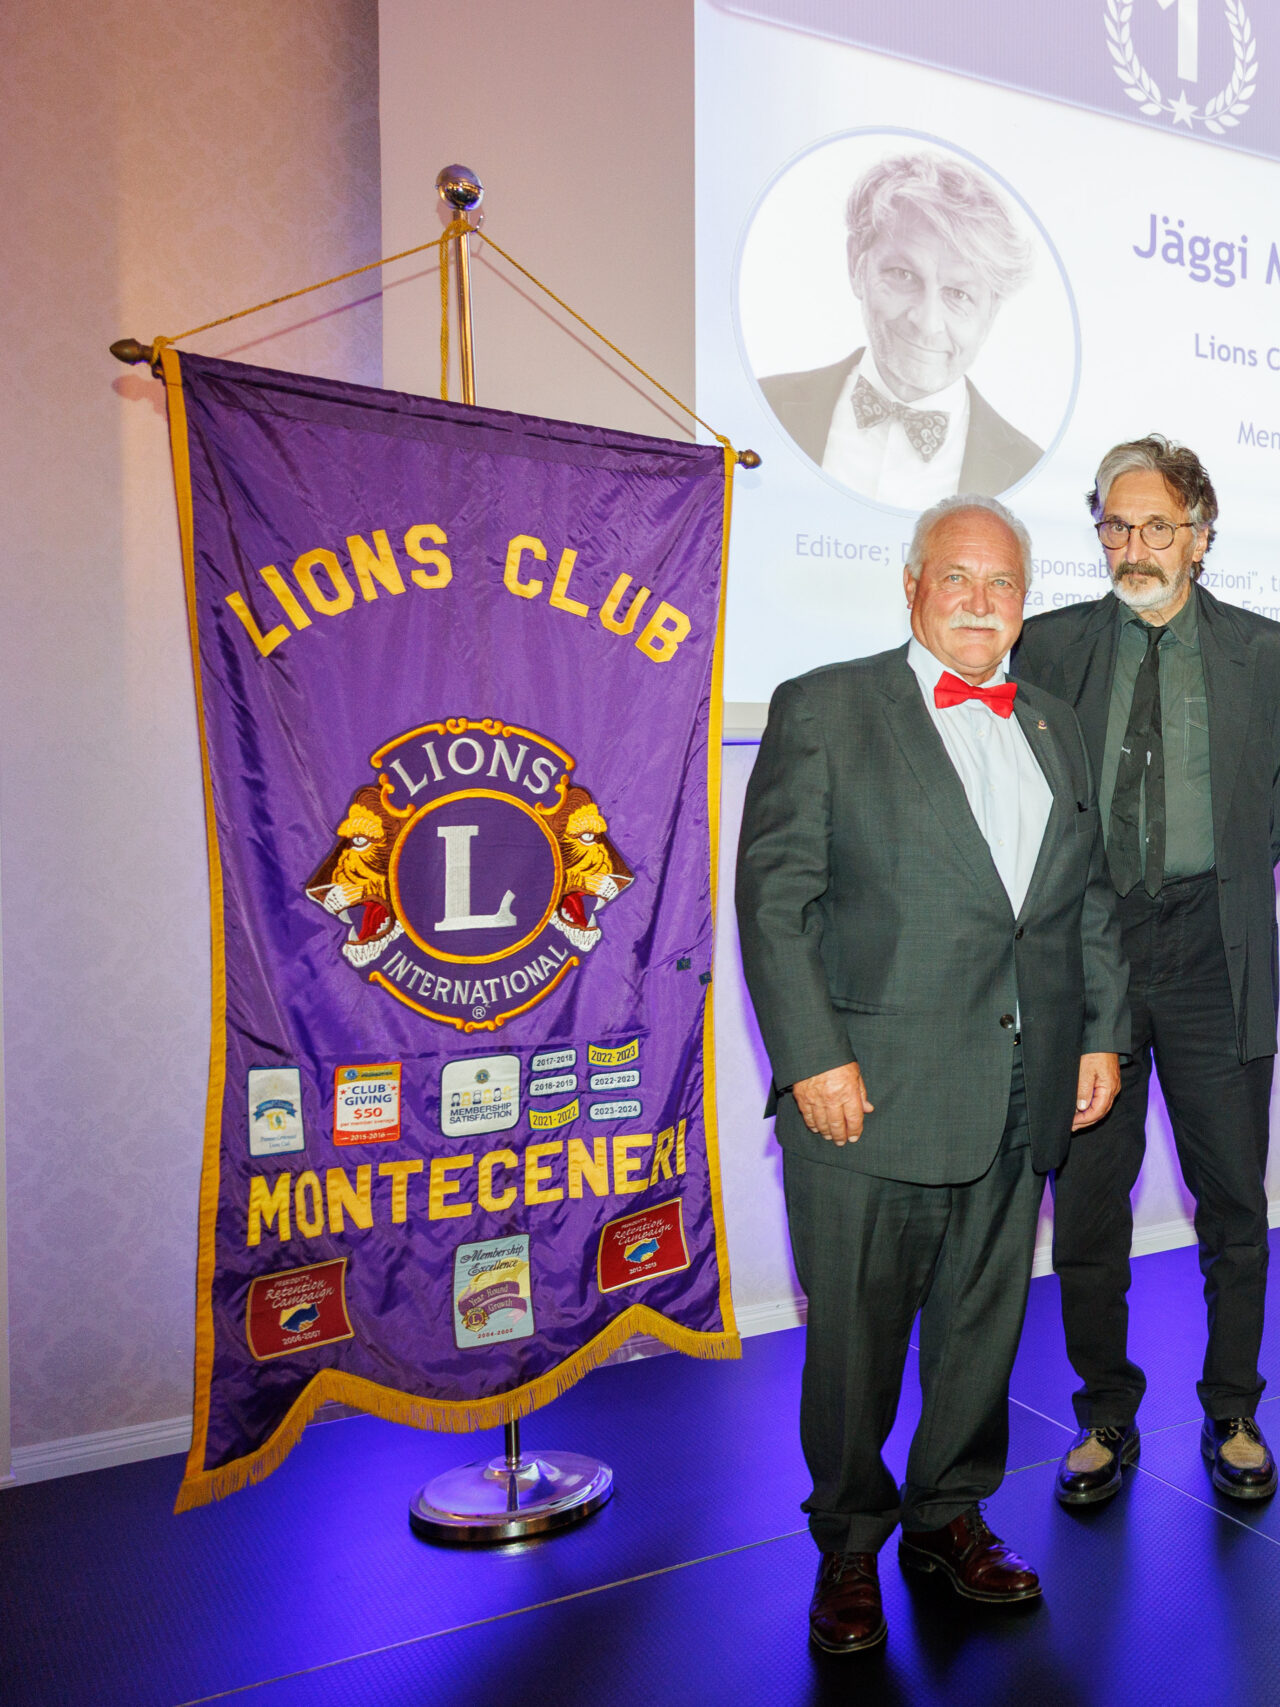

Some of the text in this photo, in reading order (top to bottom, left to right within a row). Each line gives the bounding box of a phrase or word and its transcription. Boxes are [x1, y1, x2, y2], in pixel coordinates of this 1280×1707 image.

[1132, 213, 1249, 288] Jäggi
[1193, 332, 1259, 367] Lions
[796, 533, 890, 566] Editore;
[1031, 558, 1109, 579] sponsab
[1199, 569, 1265, 595] ozioni",
[225, 523, 692, 663] LIONS CLUB
[389, 737, 558, 797] LIONS
[434, 825, 517, 931] L
[382, 944, 569, 1005] INTERNATIONAL
[536, 1054, 574, 1067] 2017-2018
[591, 1046, 637, 1063] 2022-2023
[352, 1084, 386, 1095] CLUB
[534, 1078, 574, 1092] 2018-2019
[594, 1074, 636, 1087] 2022-2023
[344, 1094, 392, 1106] GIVING
[450, 1102, 512, 1116] MEMBERSHIP
[594, 1105, 638, 1116] 2023-2024
[353, 1107, 383, 1120] $50
[449, 1109, 513, 1125] SATISFACTION
[532, 1106, 578, 1127] 2021-2022
[350, 1132, 386, 1142] 2015-2016
[246, 1120, 687, 1247] MONTECENERI
[613, 1219, 665, 1240] Retention
[618, 1224, 673, 1246] Campaign
[460, 1243, 525, 1264] Membership
[467, 1259, 519, 1276] Excellence
[264, 1279, 327, 1301] Retention
[272, 1286, 336, 1309] Campaign
[468, 1284, 509, 1307] Year Round
[488, 1298, 513, 1312] Growth
